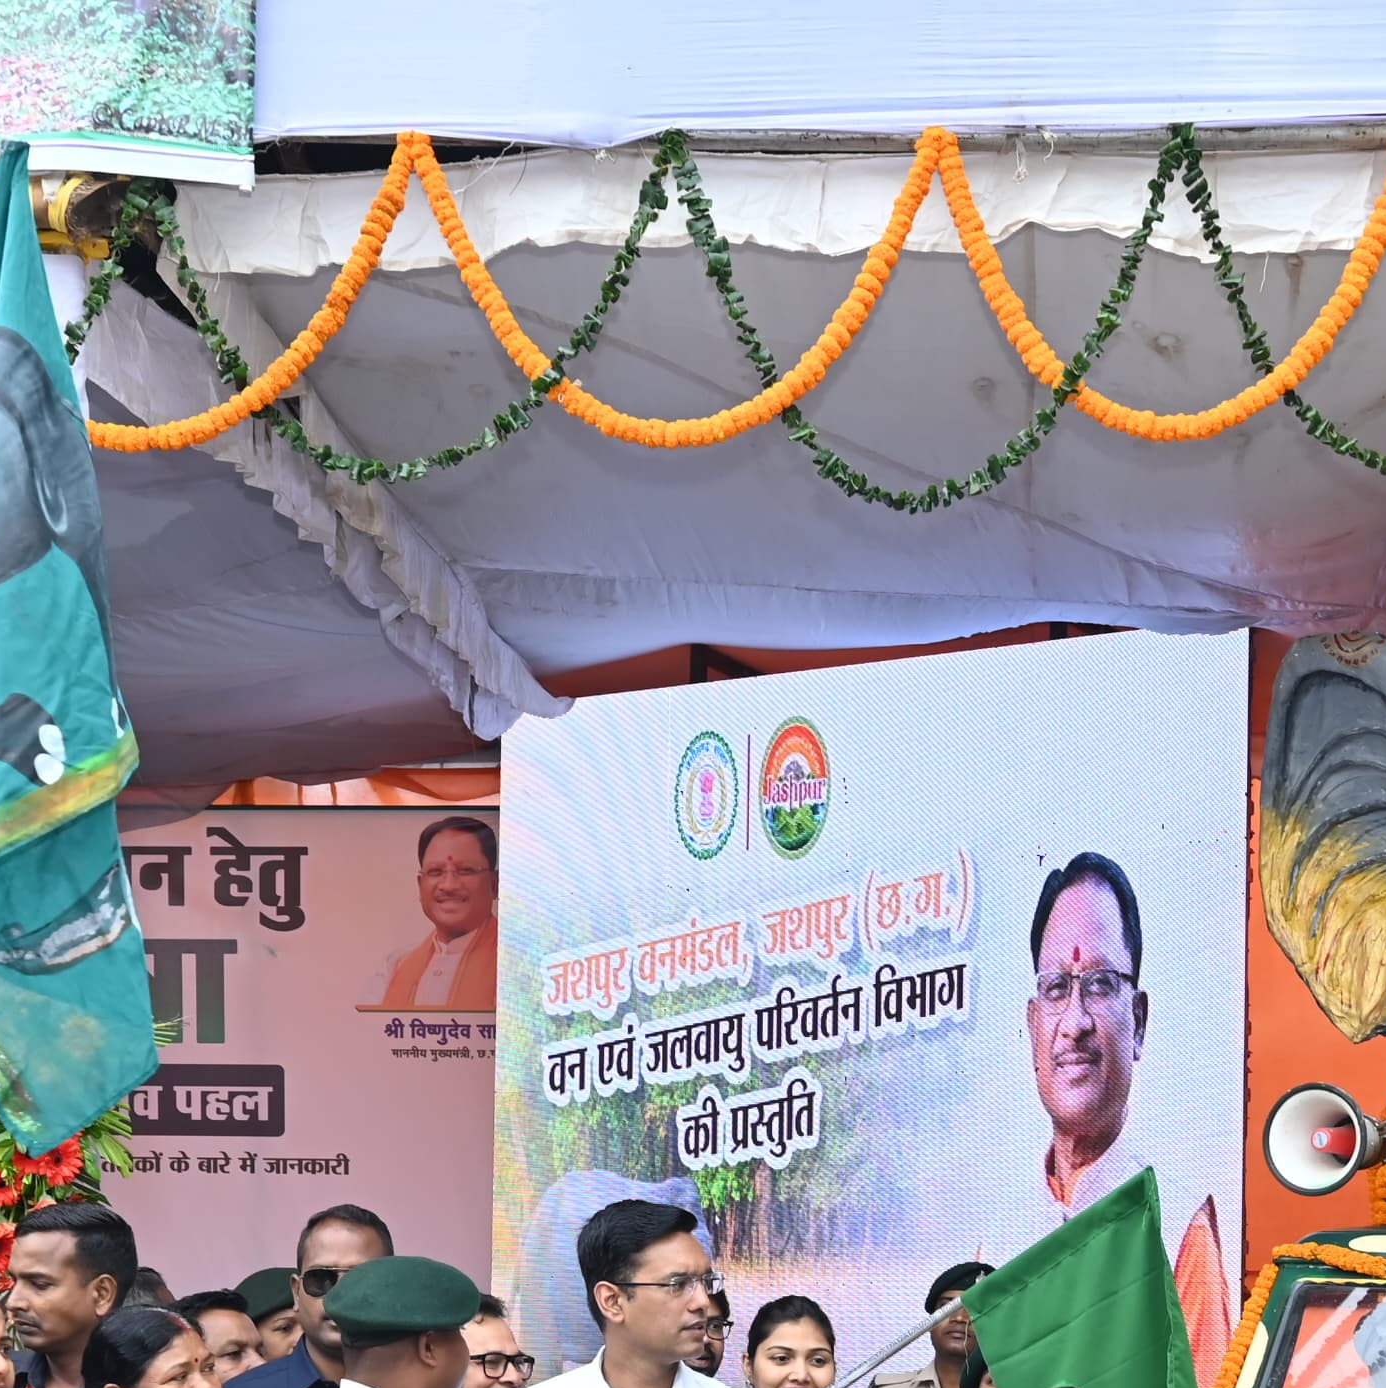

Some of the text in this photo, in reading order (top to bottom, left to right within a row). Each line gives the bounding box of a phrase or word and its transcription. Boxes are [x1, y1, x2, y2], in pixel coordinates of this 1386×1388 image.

[764, 775, 826, 812] Jashpur
[206, 827, 308, 931] हेतु
[547, 947, 627, 1008] जशपुर
[637, 918, 748, 984] वनमंडल,
[763, 894, 850, 959] जशपुर
[384, 1018, 405, 1039] श्री
[410, 1018, 471, 1045] विष्णुदेव
[548, 964, 967, 1094] वन एवं जलवायु परिवर्तन विभाग
[173, 1085, 273, 1121] पहल
[682, 1079, 815, 1158] की प्रस्तुति
[168, 1151, 191, 1173] के
[198, 1151, 231, 1174] बारे
[239, 1152, 257, 1174] में
[263, 1152, 350, 1176] जानकारी
